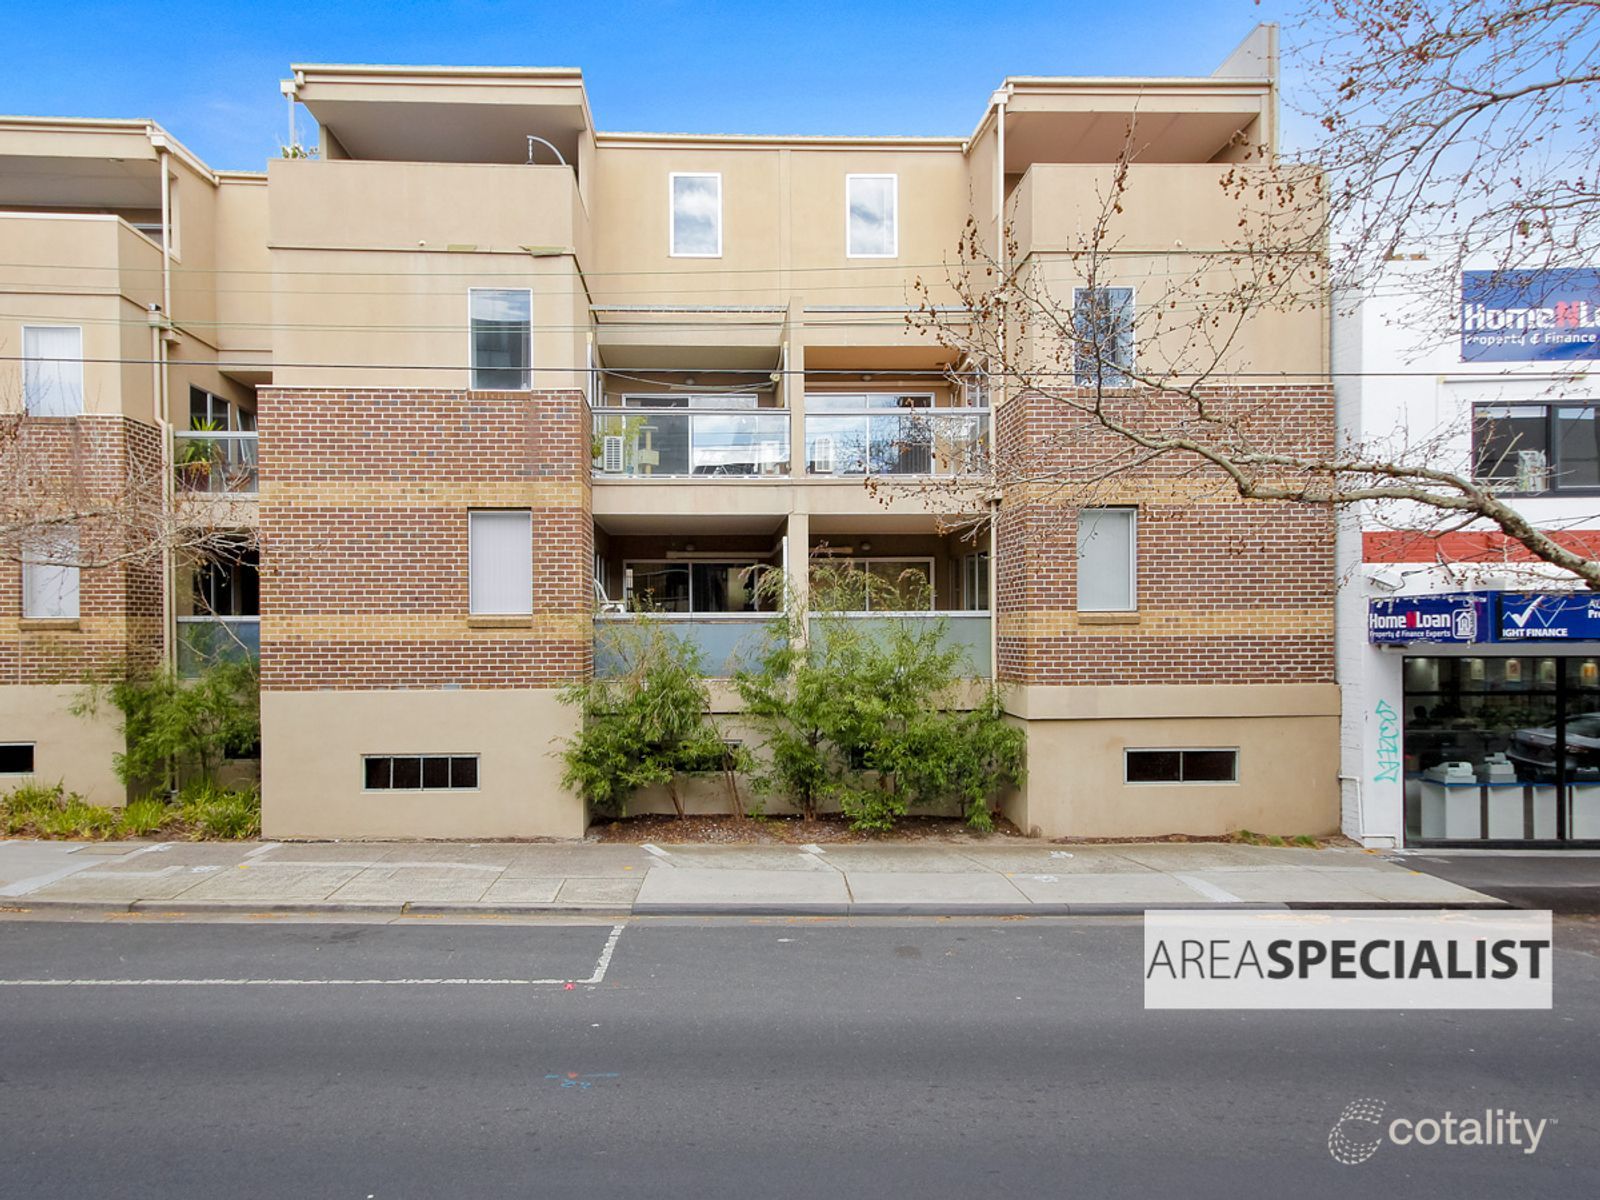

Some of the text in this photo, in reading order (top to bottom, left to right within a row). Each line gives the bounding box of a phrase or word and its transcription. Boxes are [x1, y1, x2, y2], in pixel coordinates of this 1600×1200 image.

[1464, 332, 1597, 346] Property & Finance
[1526, 628, 1568, 637] FINANCE
